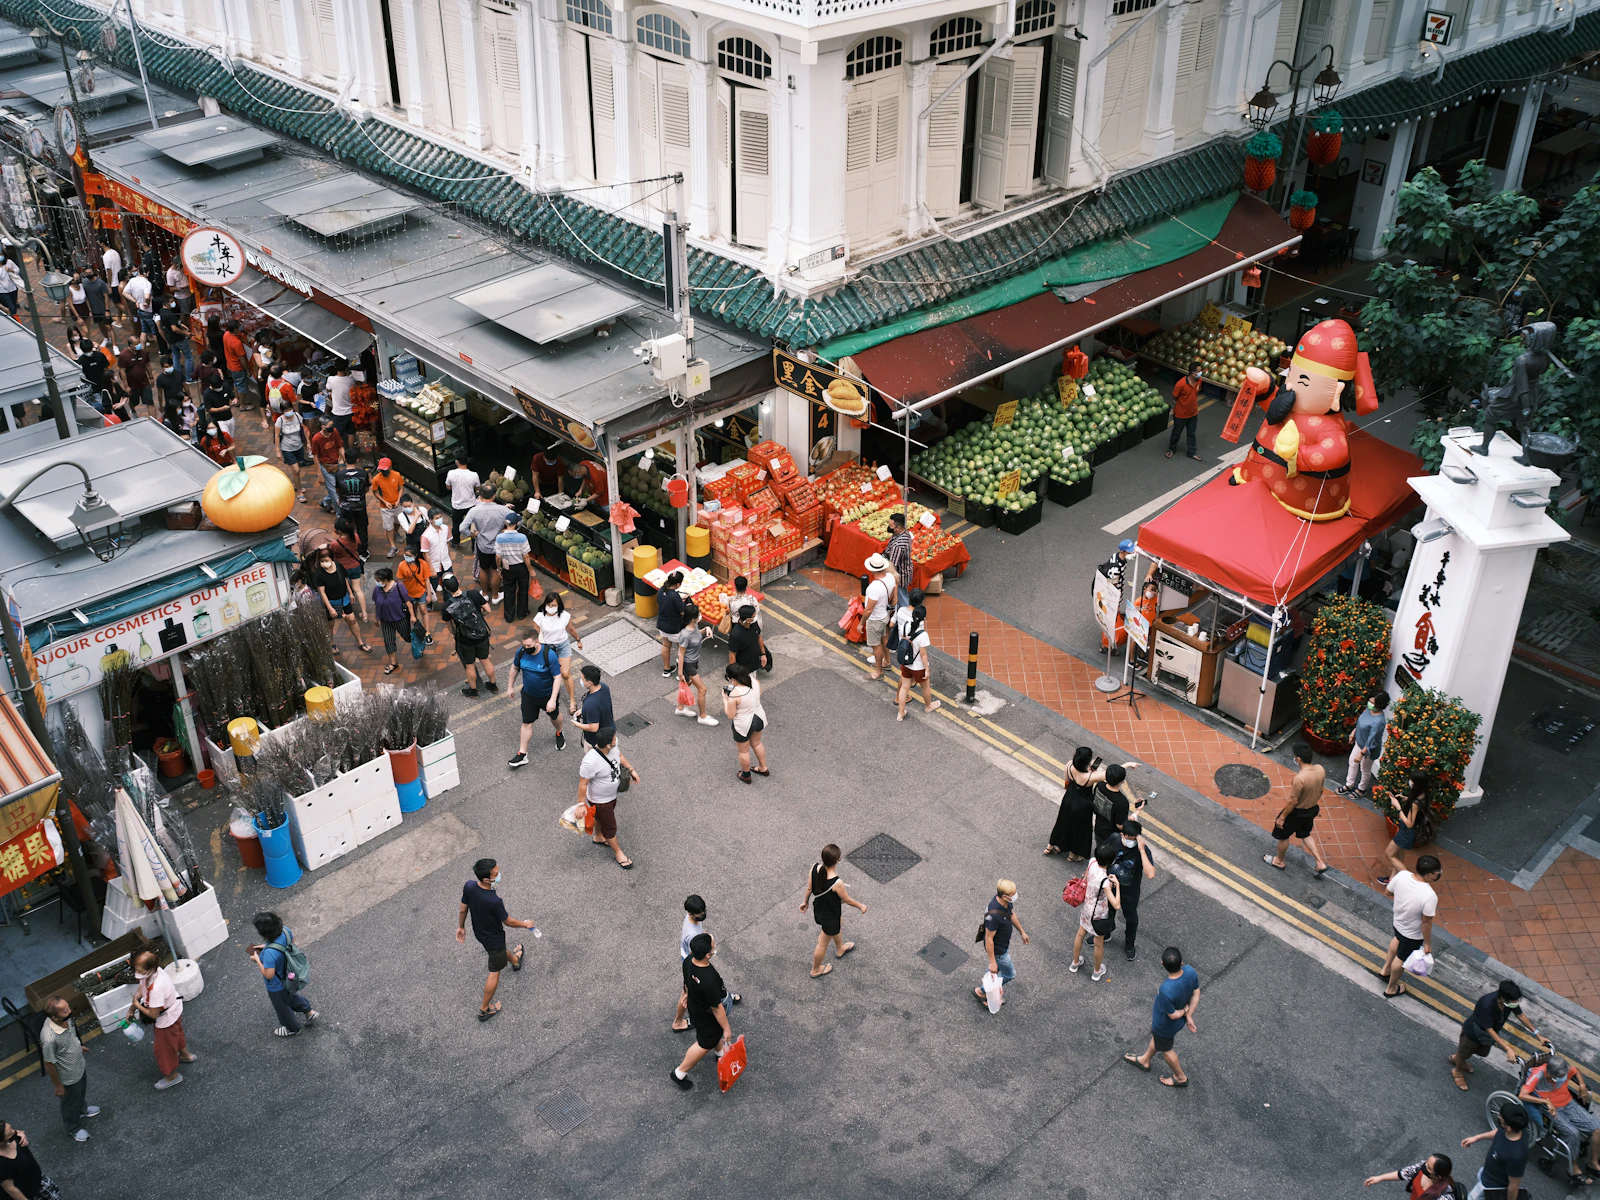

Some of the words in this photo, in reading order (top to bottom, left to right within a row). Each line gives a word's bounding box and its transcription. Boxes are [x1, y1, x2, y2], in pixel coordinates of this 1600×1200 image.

[780, 360, 825, 397] 黑金
[1165, 577, 1190, 595] CREAM
[1171, 574, 1187, 587] ICE
[10, 638, 91, 678] BNJOUR
[94, 600, 182, 643] COSMETICS
[190, 582, 229, 606] DUTY
[234, 567, 267, 588] FREE
[6, 805, 37, 834] 品
[0, 831, 52, 883] 糖果
